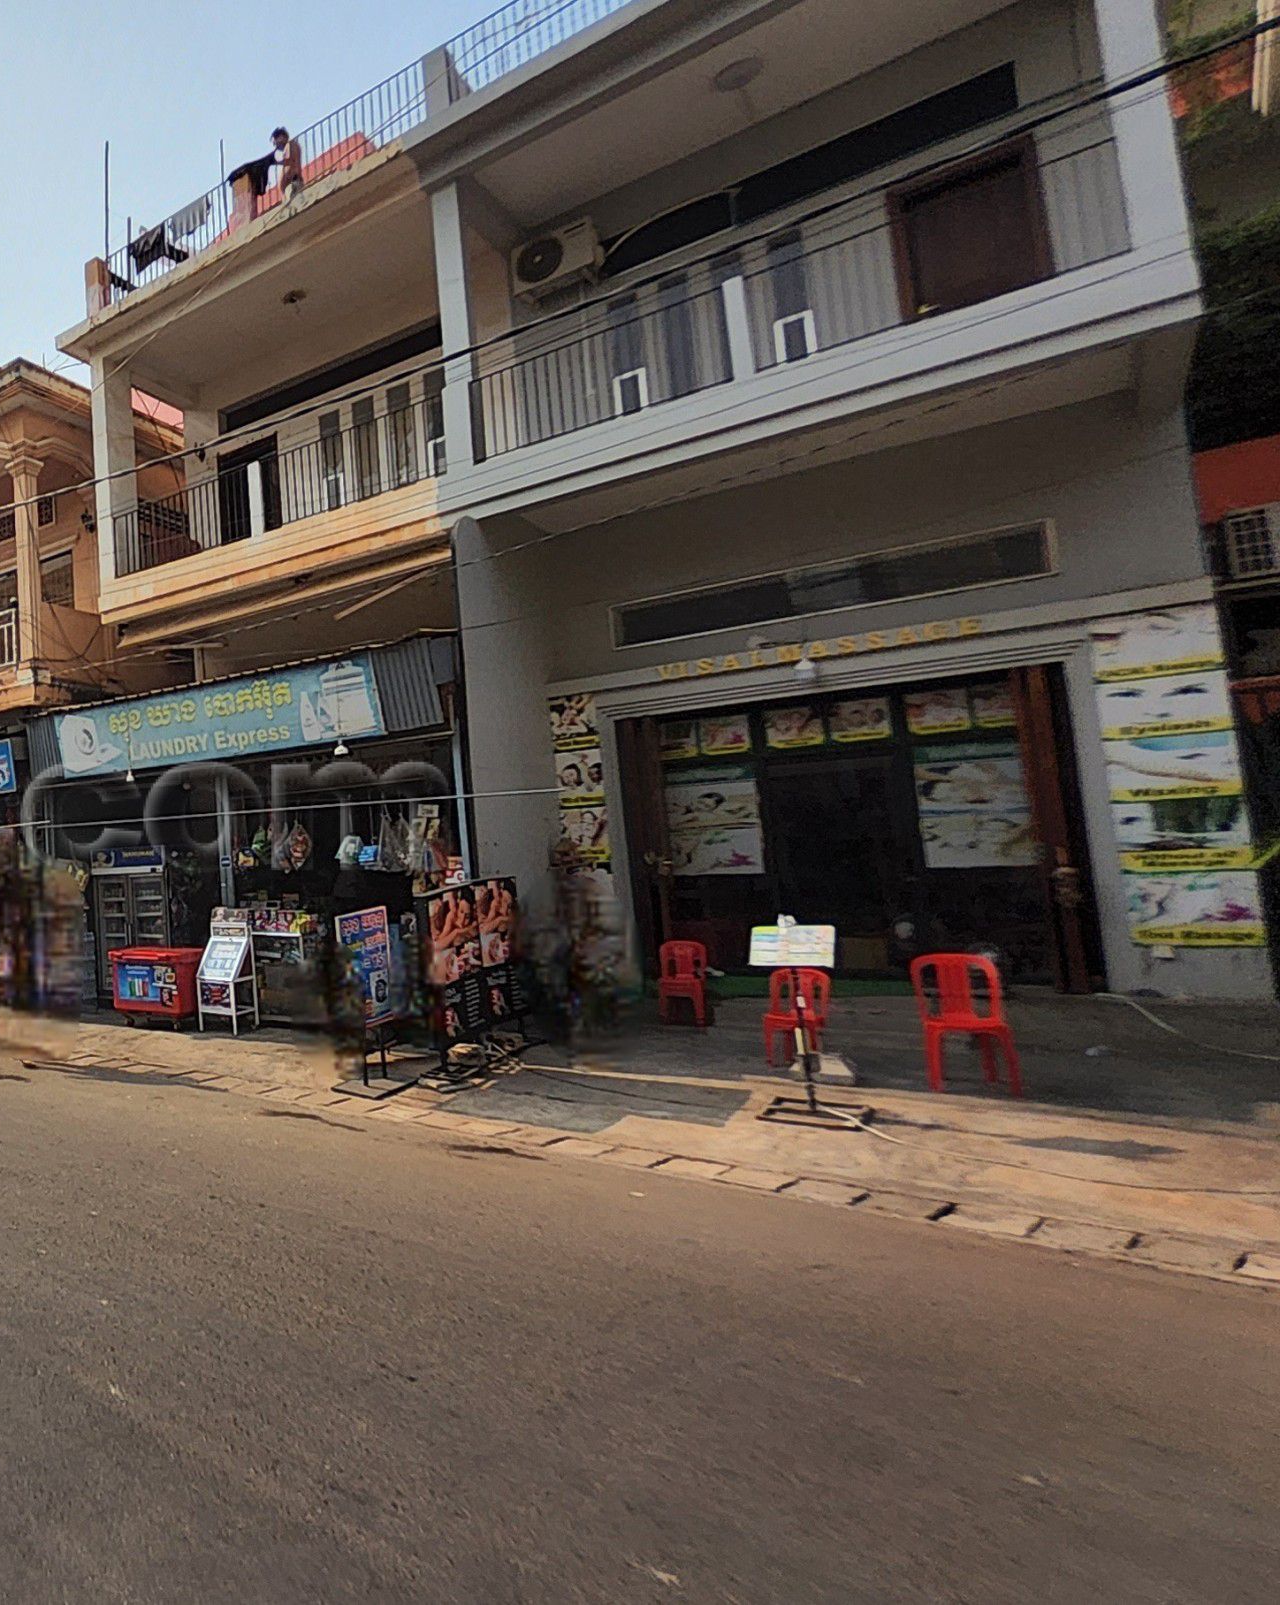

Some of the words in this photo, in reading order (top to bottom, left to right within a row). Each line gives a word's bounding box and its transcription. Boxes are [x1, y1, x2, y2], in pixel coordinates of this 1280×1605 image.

[658, 650, 765, 681] VISAL
[775, 616, 983, 664] MASSAGE
[129, 733, 210, 762] LAUNDRY
[214, 724, 292, 751] Express
